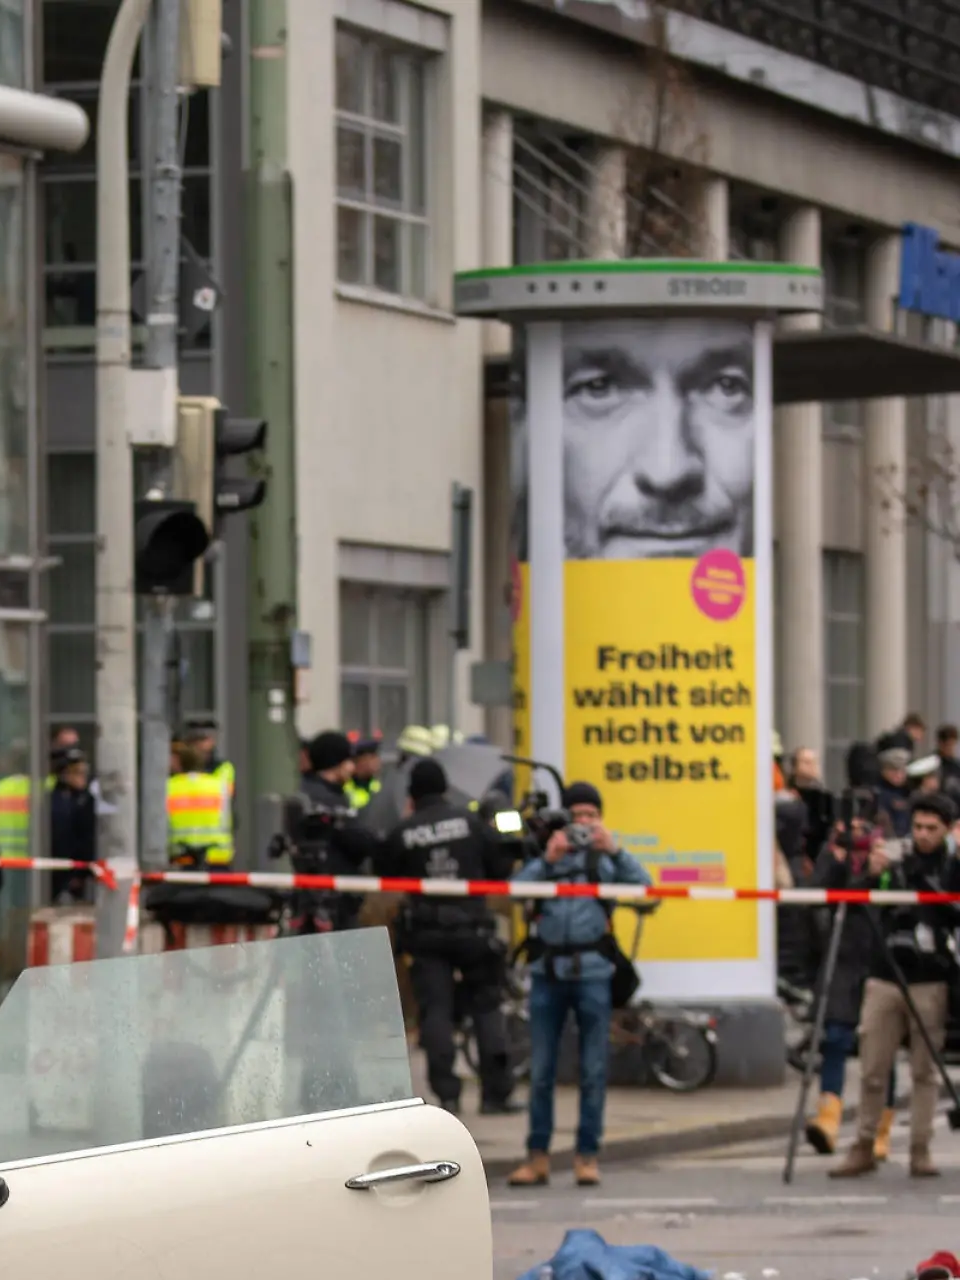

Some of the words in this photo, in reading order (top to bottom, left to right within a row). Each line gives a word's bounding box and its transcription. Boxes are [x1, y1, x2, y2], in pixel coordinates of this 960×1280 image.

[597, 643, 734, 671] Freiheit
[574, 681, 678, 707] wählt
[690, 680, 751, 707] sich
[583, 718, 679, 745] nicht
[691, 724, 744, 744] von
[605, 754, 730, 782] selbst.
